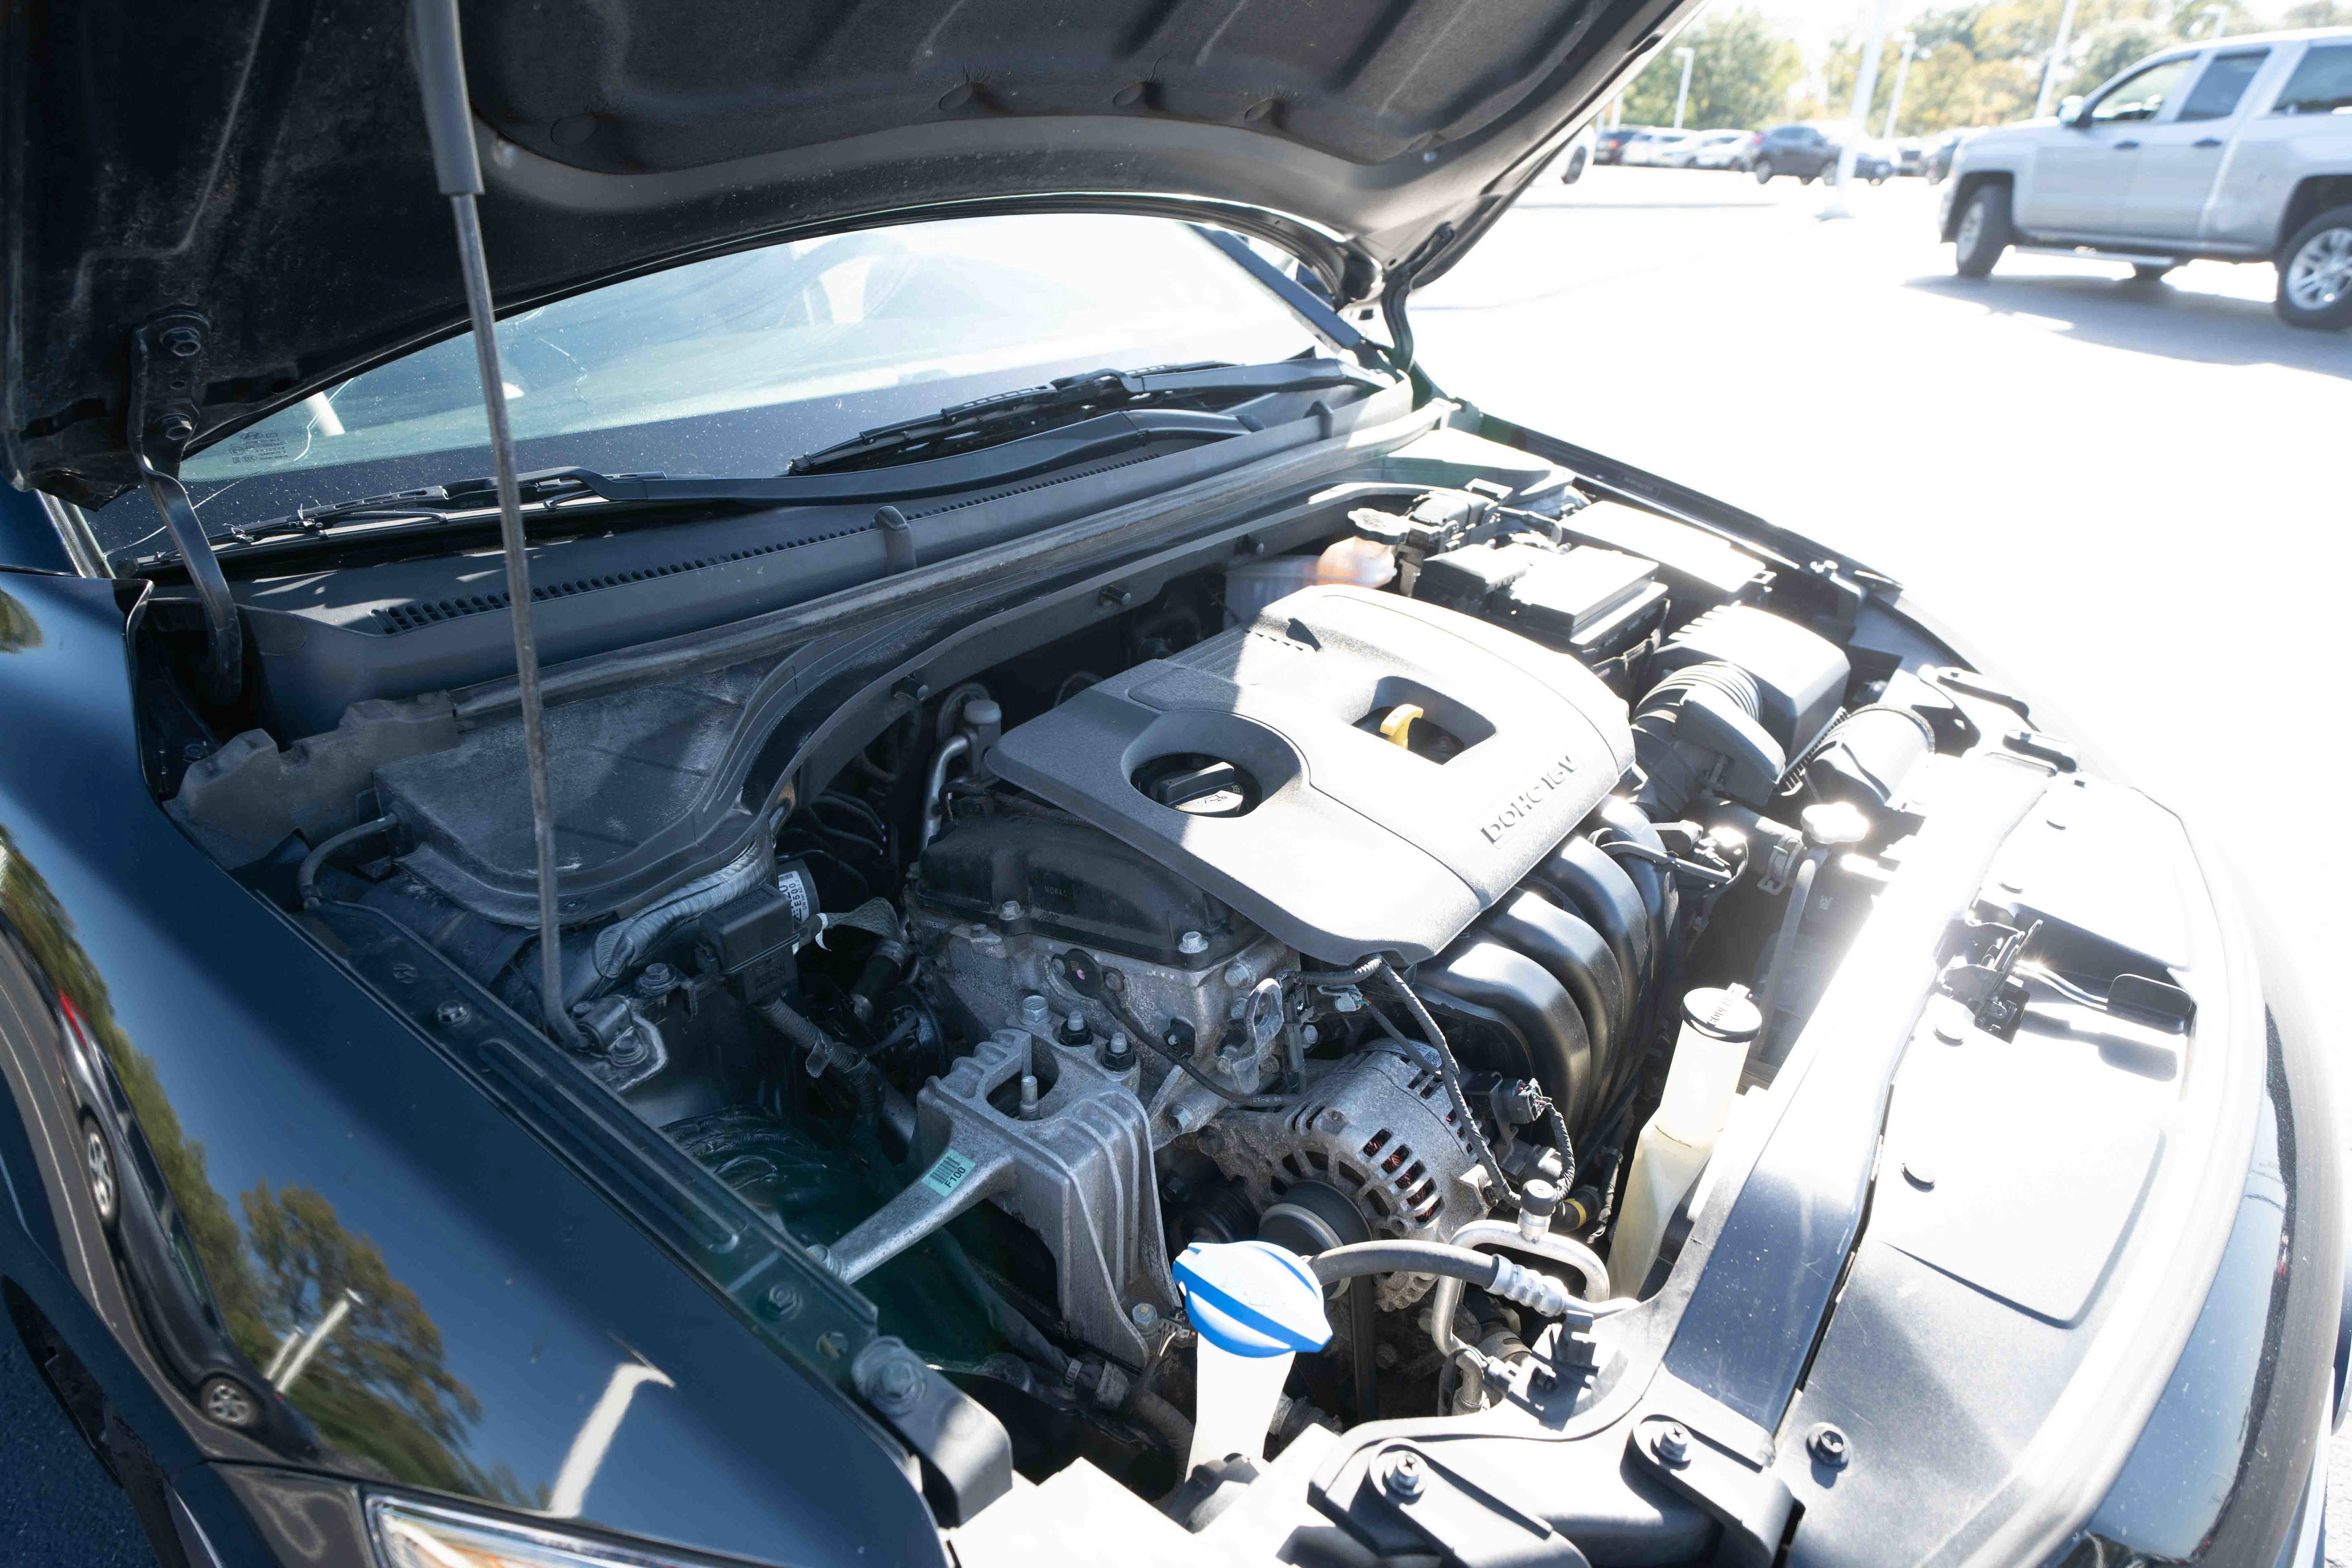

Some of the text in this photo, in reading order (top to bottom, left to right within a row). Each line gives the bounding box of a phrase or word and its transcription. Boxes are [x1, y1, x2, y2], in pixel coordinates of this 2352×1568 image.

[1480, 755, 1578, 844] DOHC 16V
[789, 883, 802, 906] E500
[944, 1166, 966, 1188] F100
